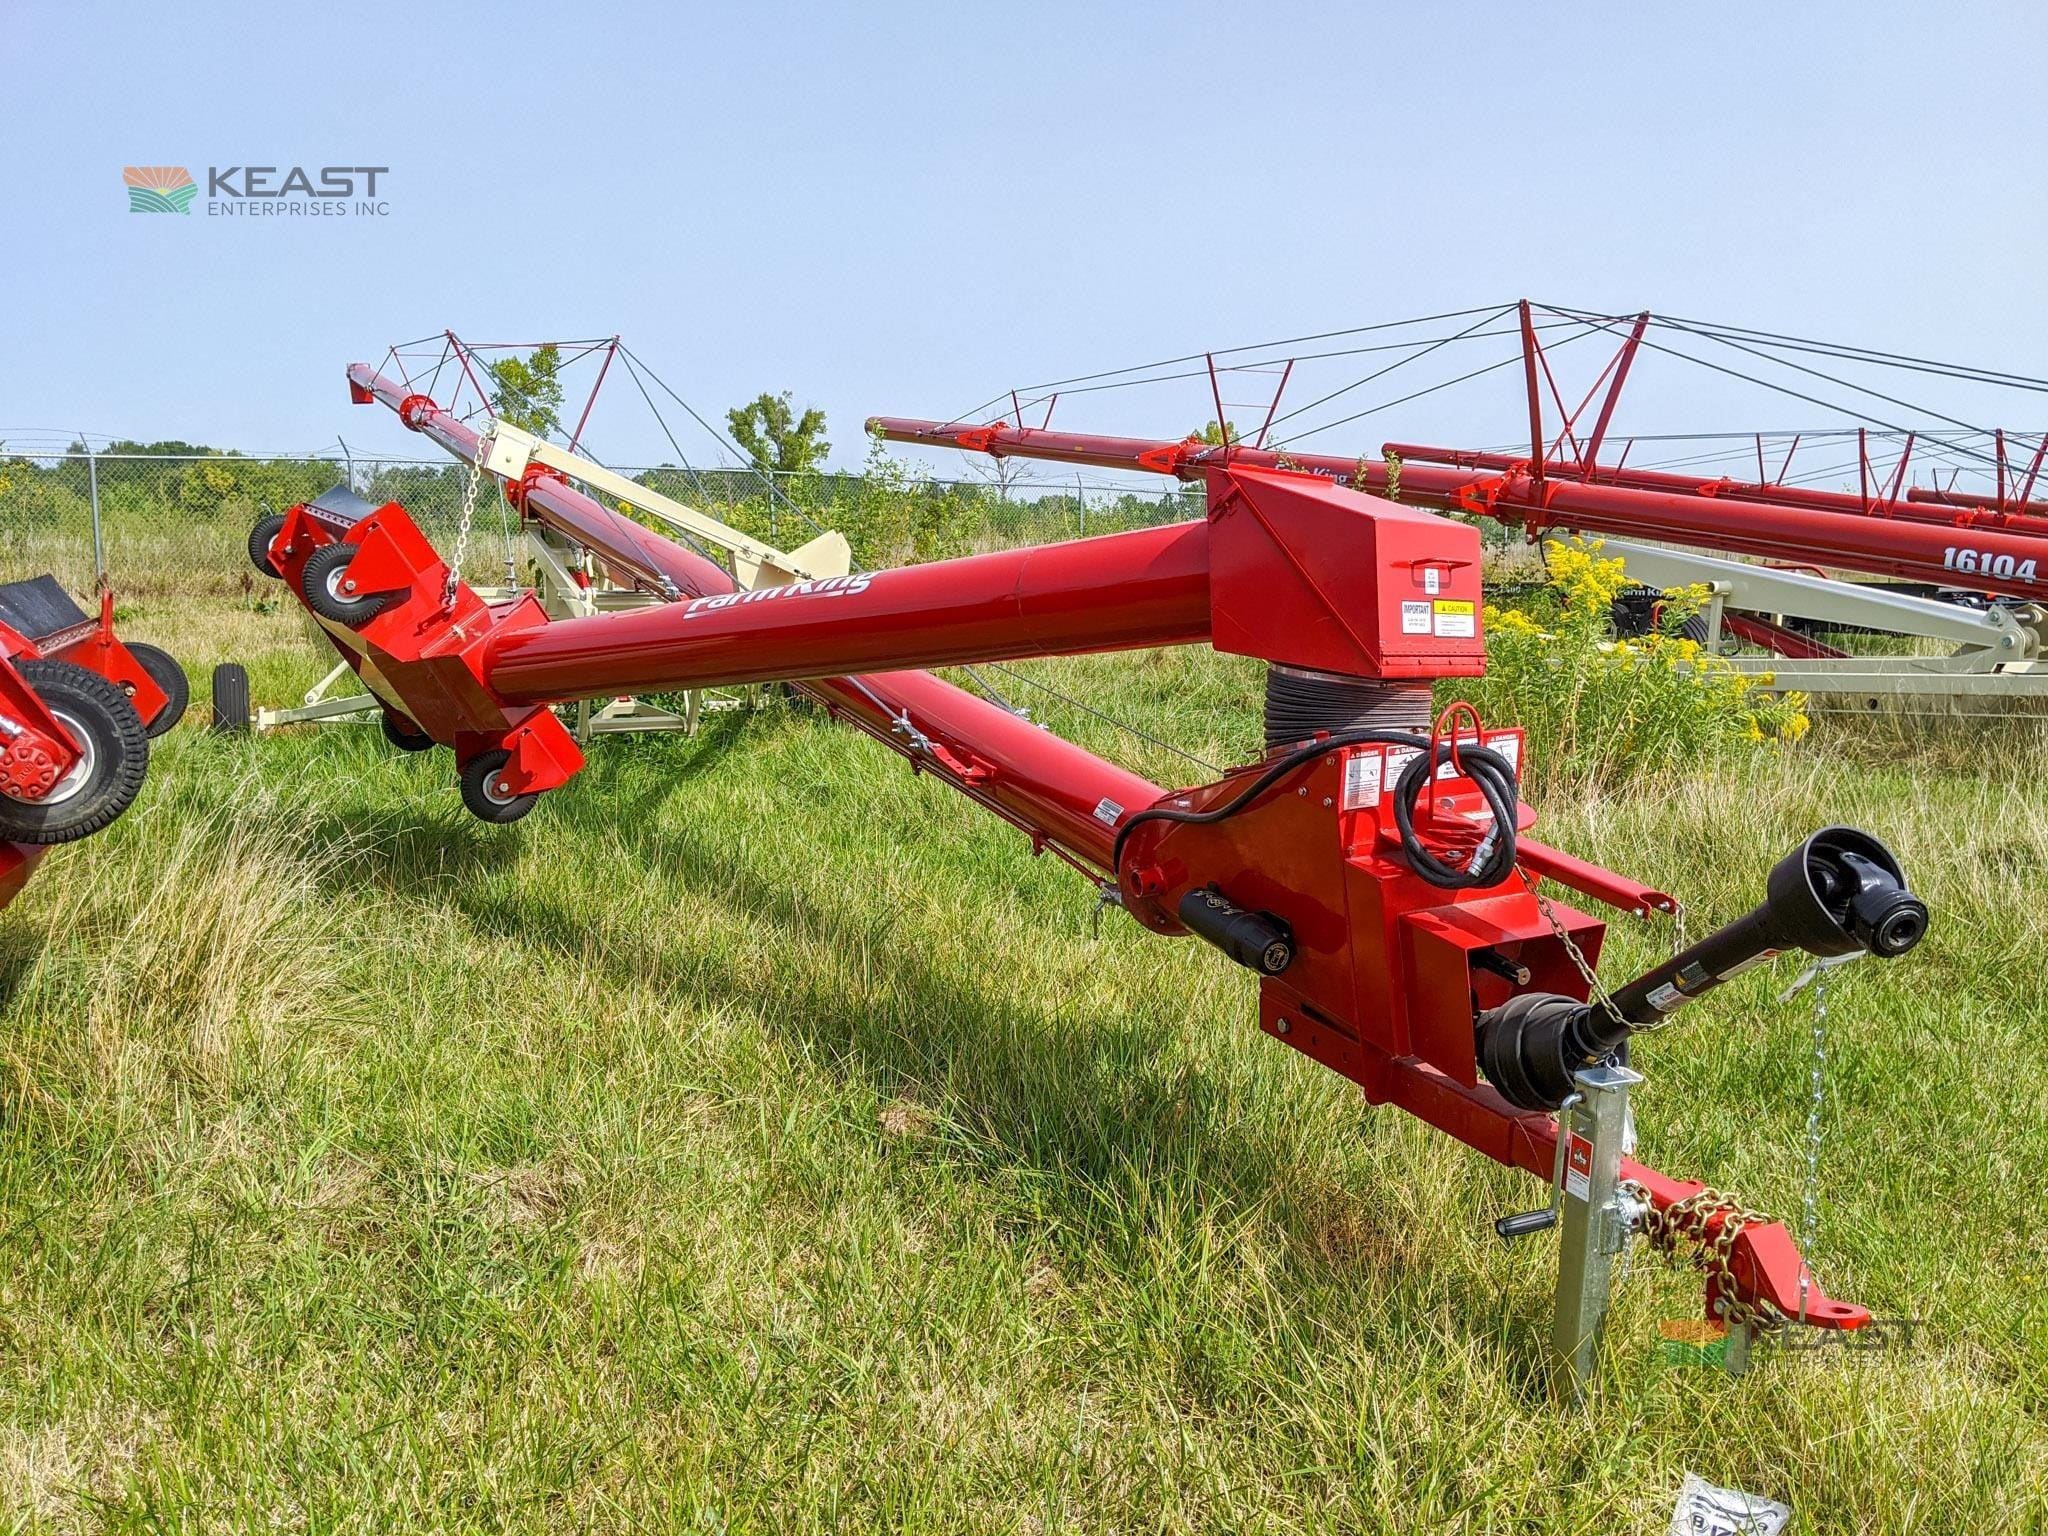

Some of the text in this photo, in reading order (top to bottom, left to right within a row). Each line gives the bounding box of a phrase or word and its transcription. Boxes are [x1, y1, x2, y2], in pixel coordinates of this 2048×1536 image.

[1943, 546, 2037, 584] 16104
[1403, 603, 1430, 615] IMPORTANT
[1447, 604, 1468, 614] CAUTION
